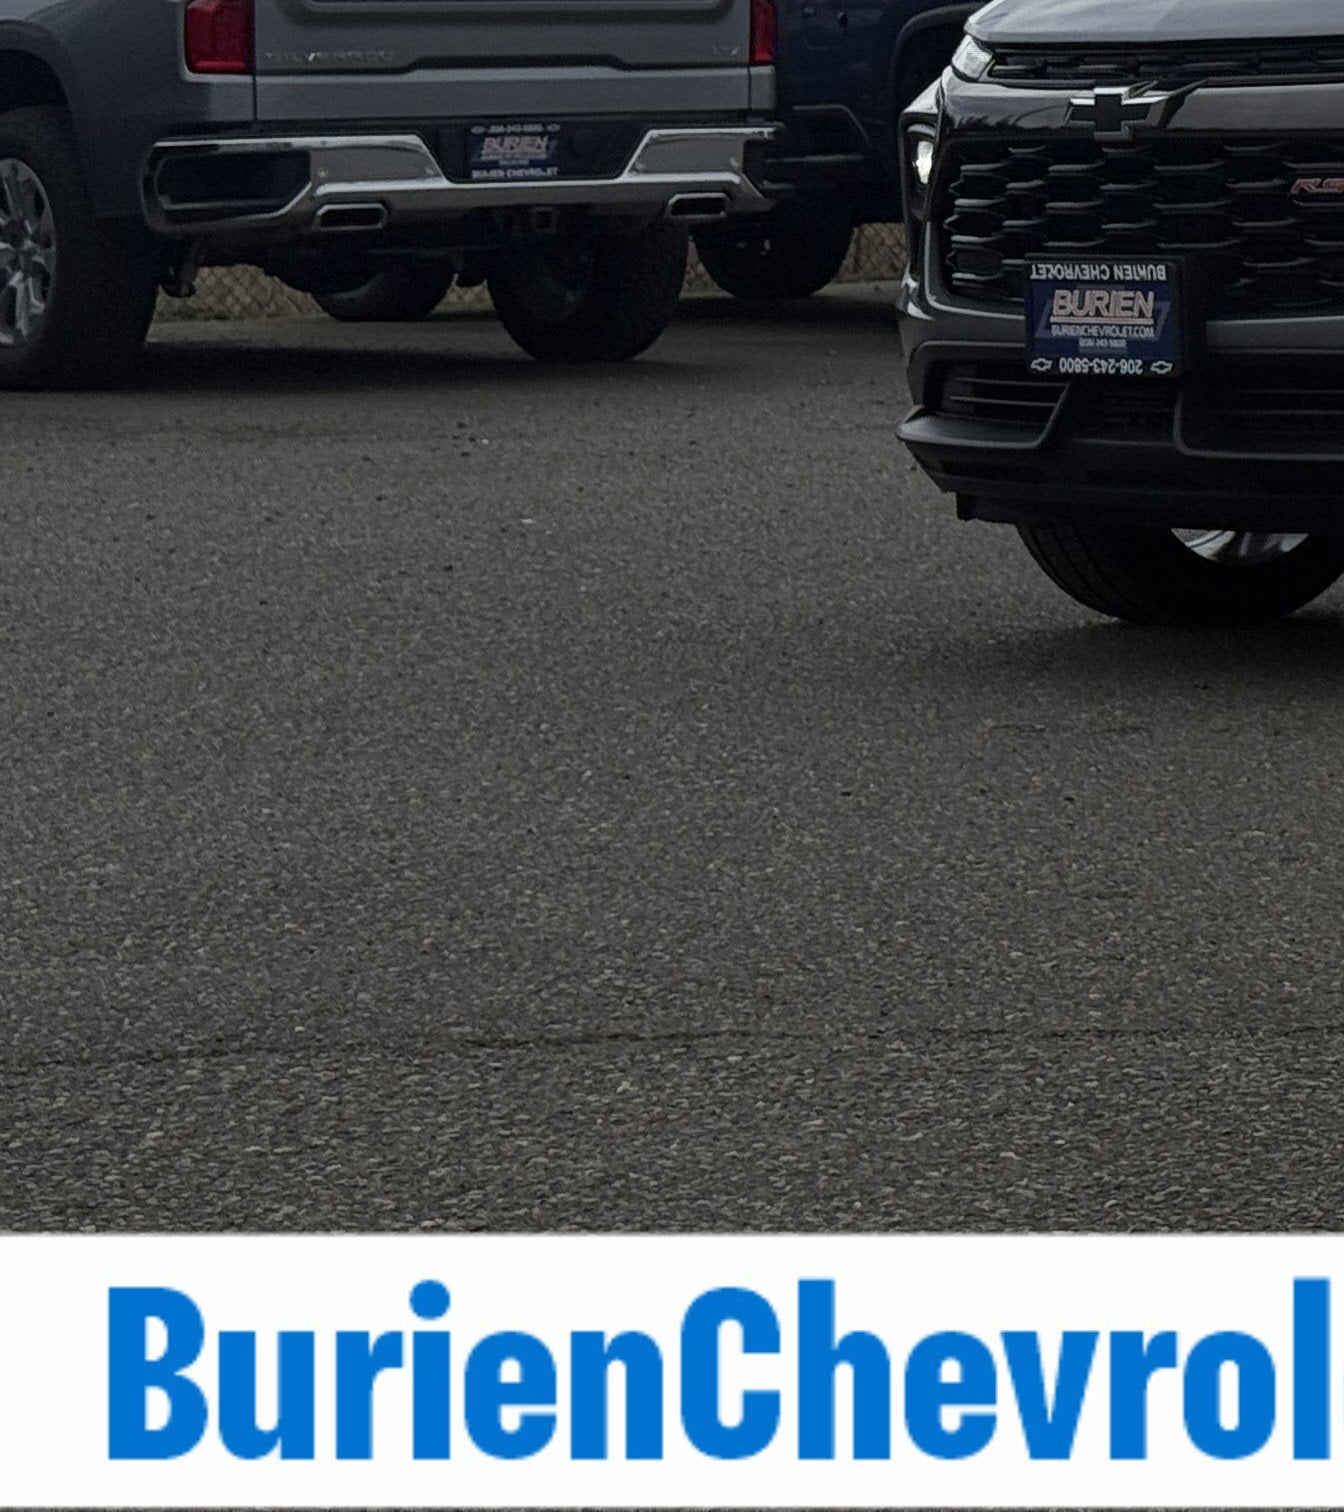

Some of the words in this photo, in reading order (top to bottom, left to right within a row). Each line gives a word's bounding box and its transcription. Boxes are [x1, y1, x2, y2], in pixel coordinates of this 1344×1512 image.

[1030, 263, 1111, 280] CHEVROLET
[1113, 264, 1167, 281] BURIEN
[1052, 289, 1155, 317] BURIEN
[1058, 357, 1143, 375] 206-243-5800
